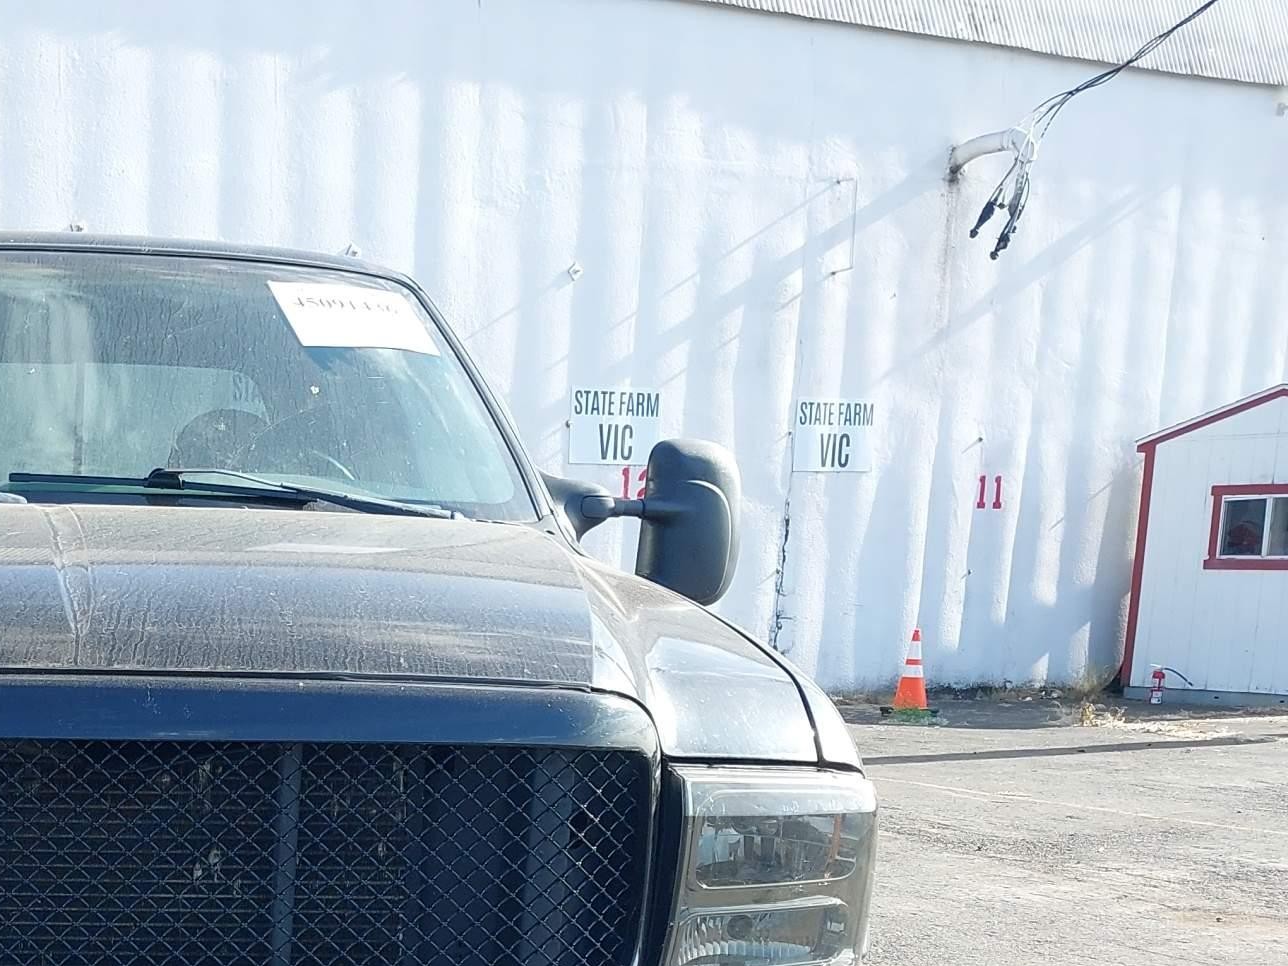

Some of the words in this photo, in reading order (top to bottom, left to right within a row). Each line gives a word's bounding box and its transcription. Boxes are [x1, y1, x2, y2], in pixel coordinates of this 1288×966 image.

[574, 390, 615, 416] STATE
[619, 391, 660, 417] FARM
[799, 401, 835, 426] STATE
[838, 402, 874, 427] FARM
[598, 423, 634, 461] VIC
[819, 432, 851, 468] VIC
[976, 475, 1002, 510] 11
